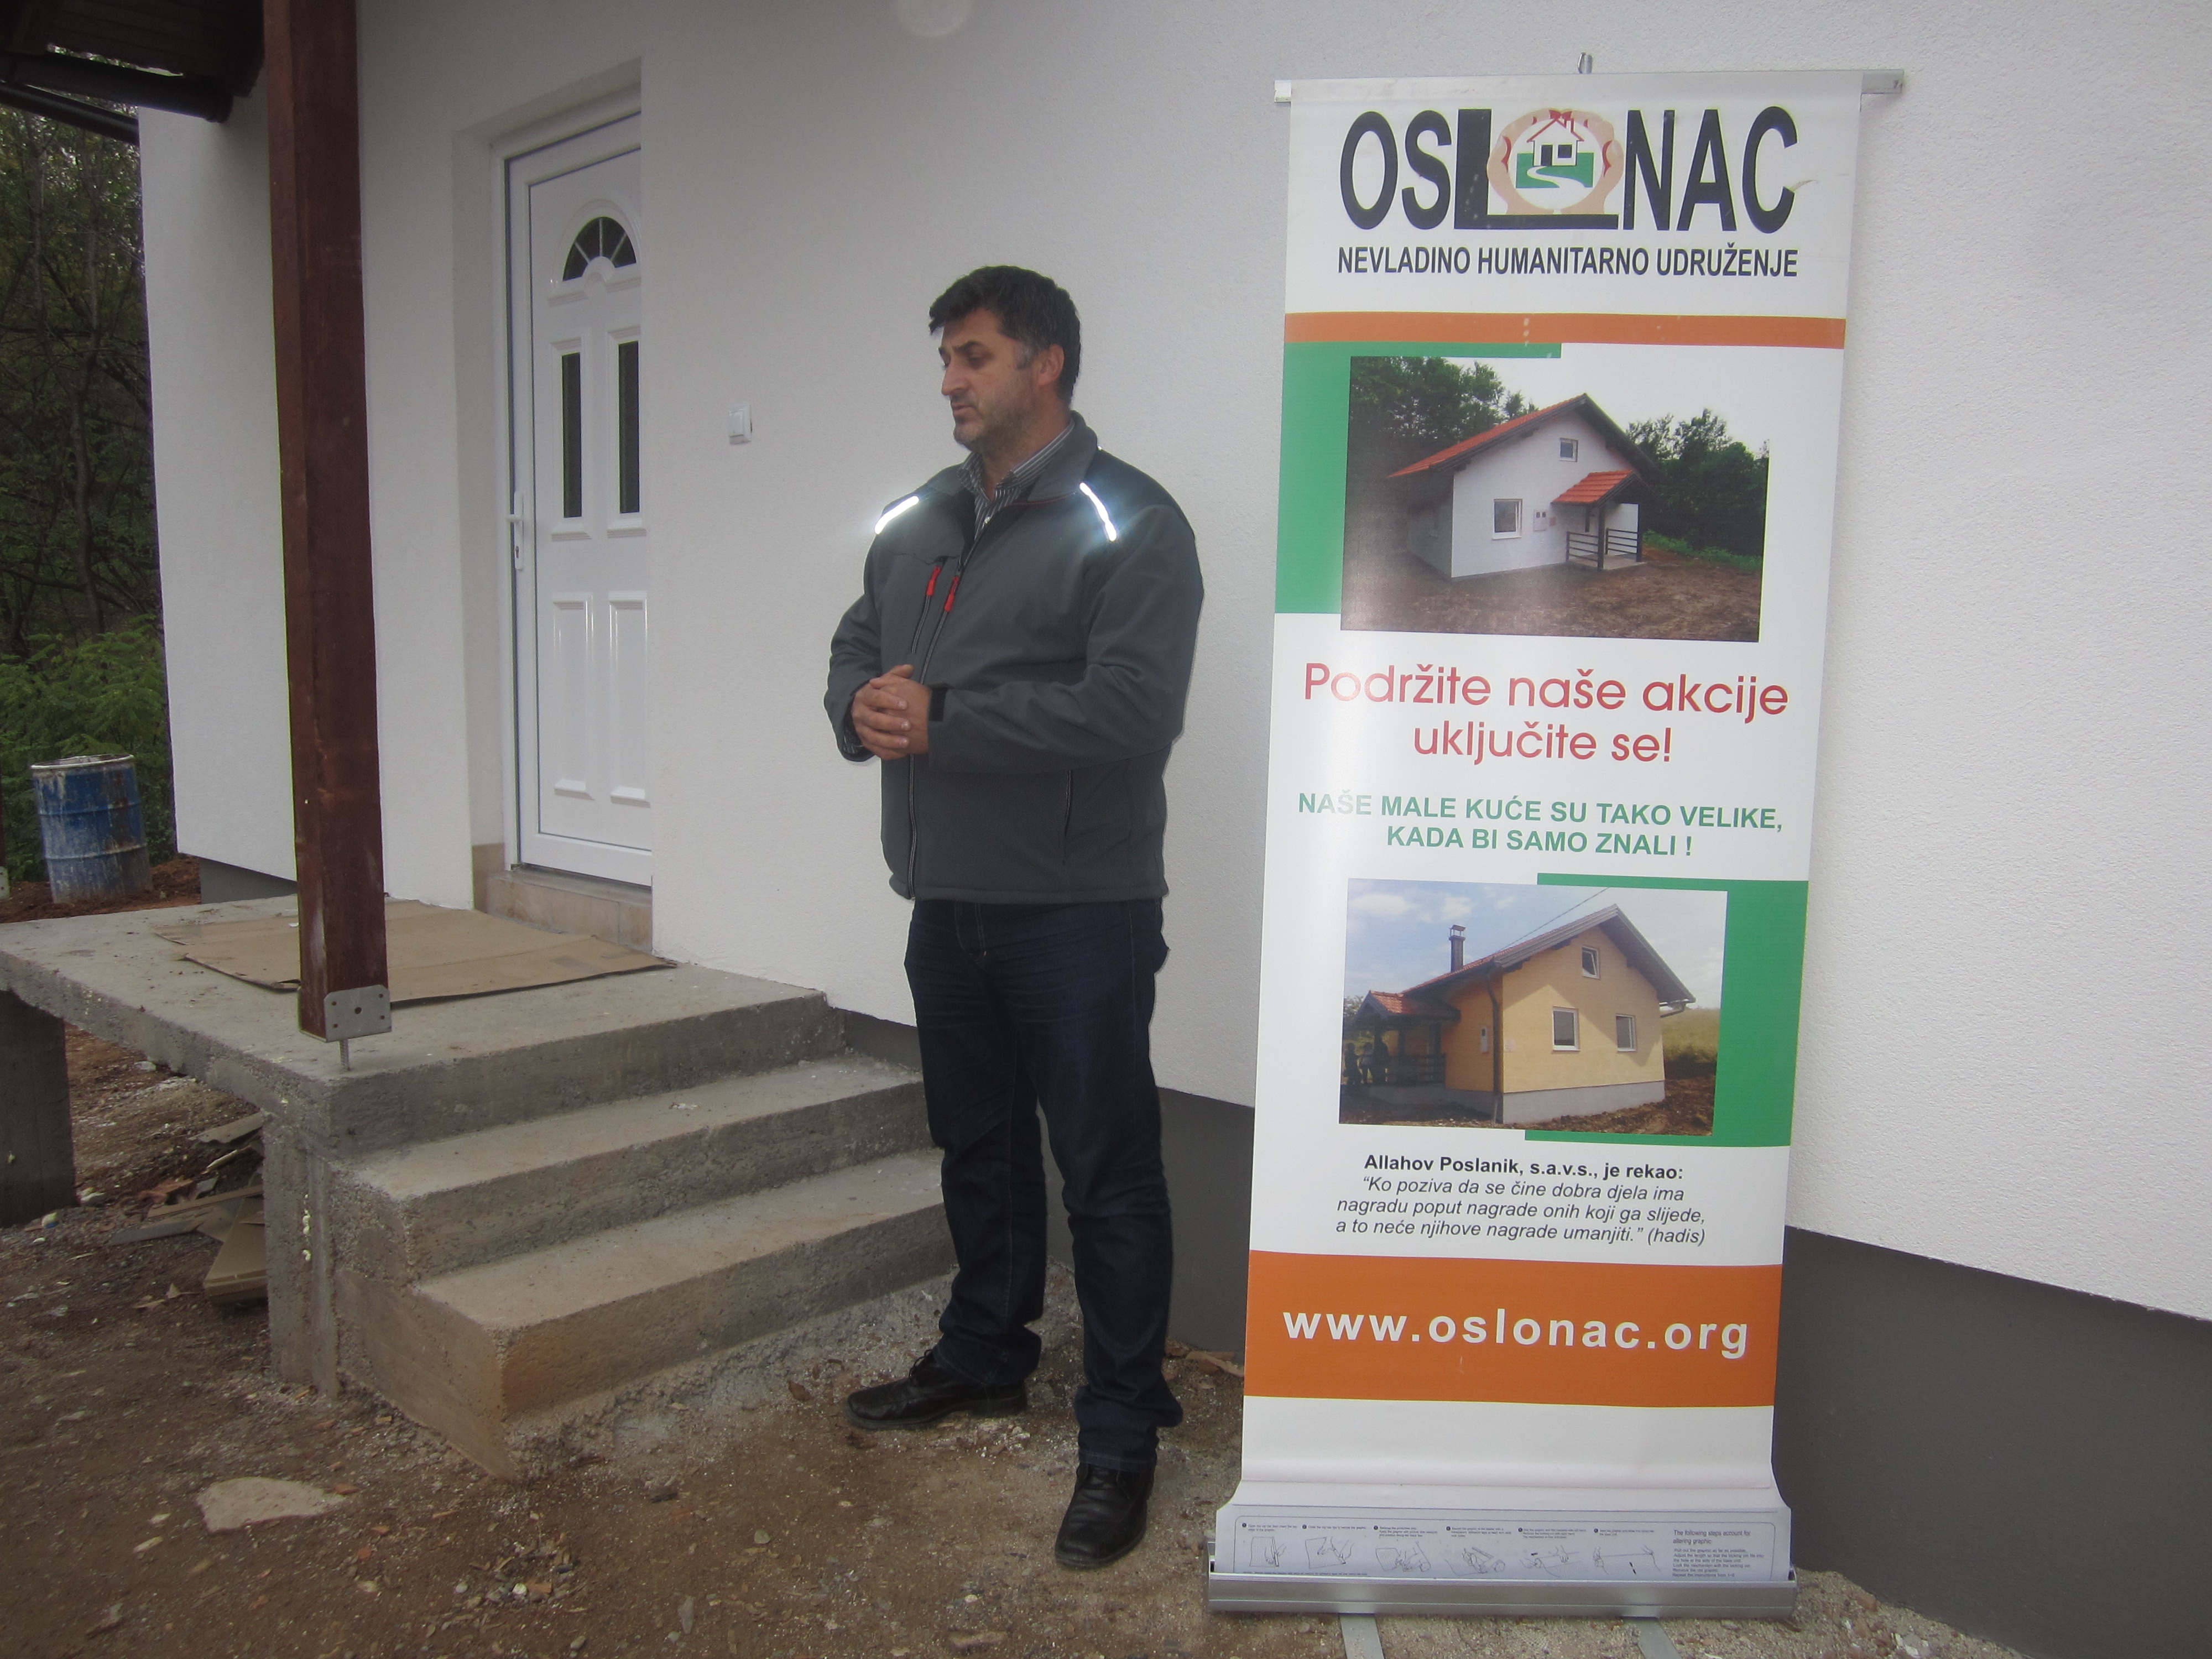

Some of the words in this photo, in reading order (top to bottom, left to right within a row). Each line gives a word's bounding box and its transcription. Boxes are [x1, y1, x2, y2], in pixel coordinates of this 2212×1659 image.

[1339, 247, 1470, 274] NEVLADINO
[1478, 247, 1648, 275] HUMANITARNO
[1657, 242, 1798, 276] UDRUŽENJE
[1306, 663, 1491, 705] Podržite
[1509, 669, 1626, 709] naše
[1643, 674, 1788, 723] akcije
[1415, 721, 1597, 765] uključite
[1611, 728, 1671, 761] se!
[1298, 789, 1371, 815] NAŠE
[1382, 796, 1456, 818] MALE
[1466, 795, 1541, 821] KUĆE
[1551, 802, 1587, 822] SU
[1597, 803, 1671, 825] TAKO
[1680, 806, 1782, 832] VELIKE,
[1388, 826, 1464, 848] KADA
[1473, 829, 1497, 849] BI
[1507, 830, 1587, 852] SAMO
[1595, 833, 1676, 855] ZNALI
[1686, 836, 1692, 856] !
[1364, 1155, 1434, 1170] Allahov
[1441, 1157, 1523, 1176] Poslanik,
[1530, 1164, 1597, 1178] s.a.v.s.,
[1603, 1163, 1620, 1181] je
[1626, 1164, 1682, 1179] rekao:
[1396, 1178, 1452, 1195] poziva
[1458, 1179, 1479, 1193] da
[1485, 1183, 1505, 1194] se
[1511, 1181, 1546, 1196] čine
[1552, 1183, 1601, 1198] dobra
[1608, 1185, 1647, 1202] djela
[1653, 1186, 1684, 1201] ima
[1337, 1198, 1408, 1215] nagradu
[1412, 1201, 1462, 1217] poput
[1467, 1202, 1537, 1219] nagrade
[1543, 1204, 1579, 1218] onih
[1585, 1204, 1615, 1222] koji
[1619, 1209, 1641, 1224] ga
[1647, 1207, 1704, 1225] slijede,
[1336, 1222, 1346, 1232] a
[1350, 1218, 1368, 1233] to
[1374, 1220, 1415, 1234] neće
[1421, 1220, 1480, 1238] njihove
[1487, 1224, 1557, 1240] nagrade
[1648, 1228, 1705, 1246] (hadis)
[1283, 1309, 1747, 1359] www.oslonac.org
